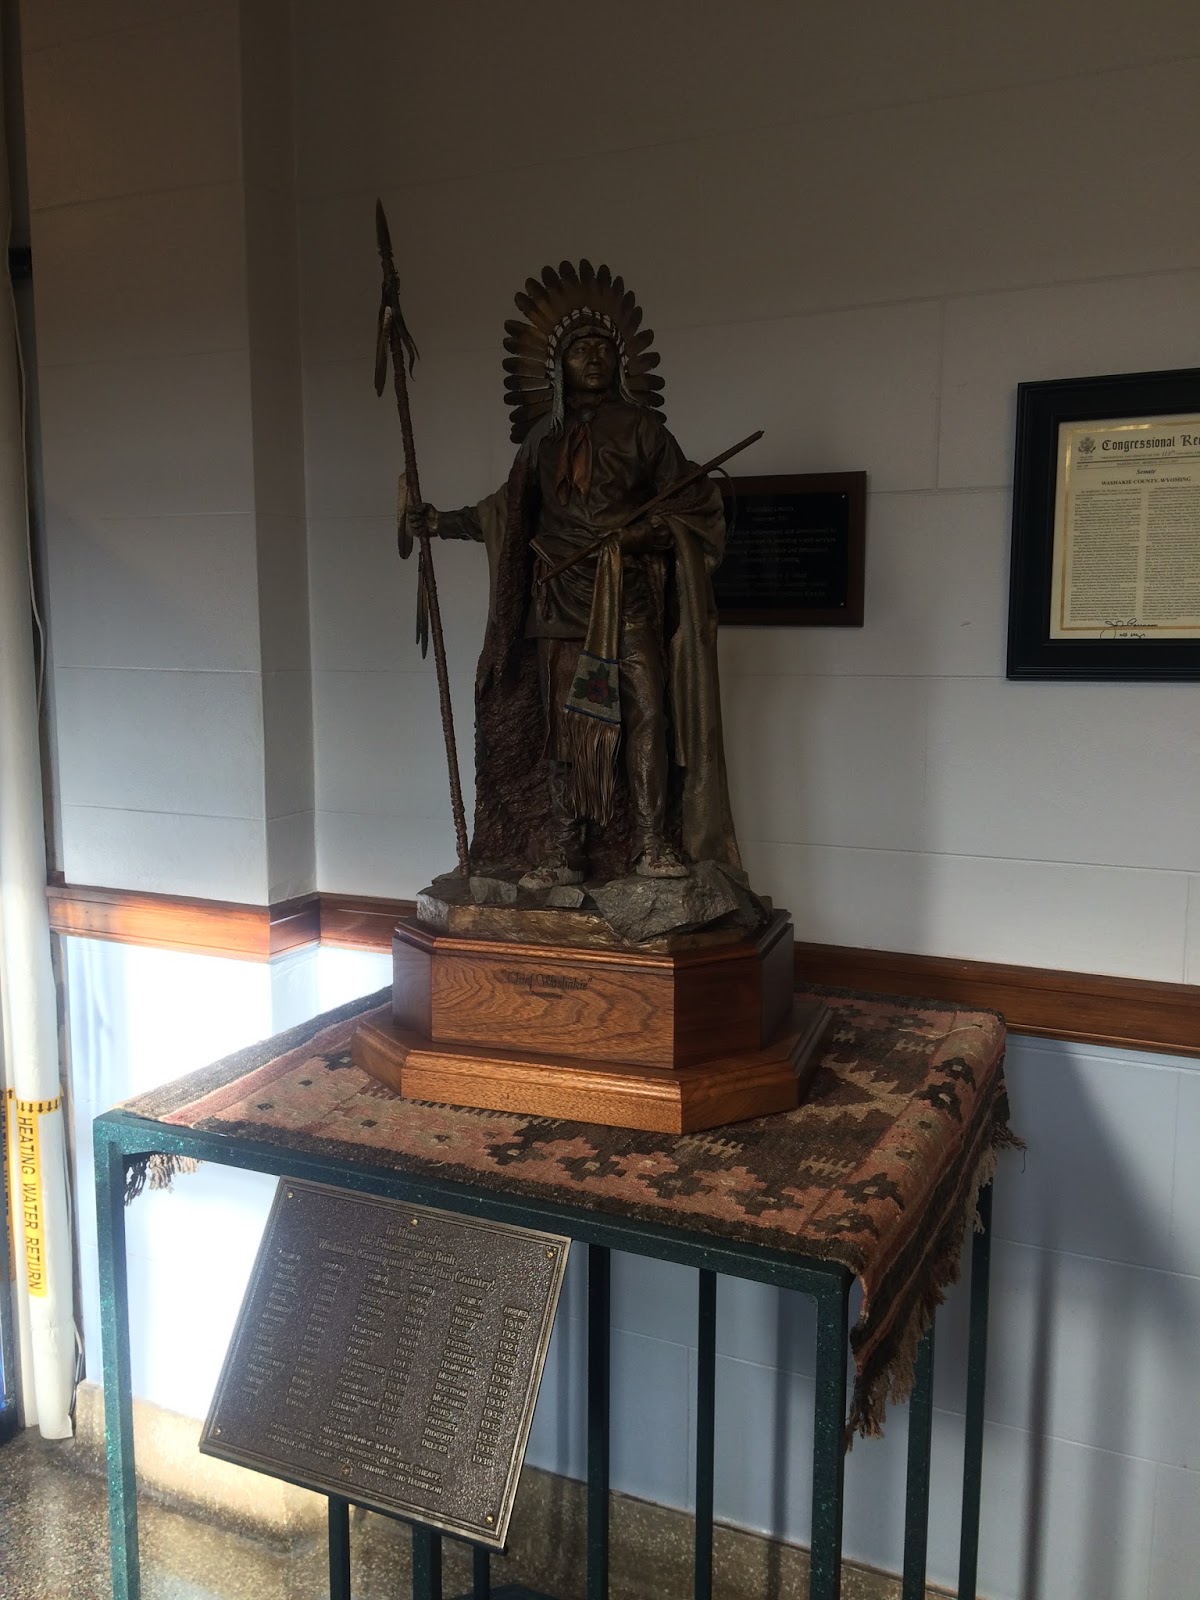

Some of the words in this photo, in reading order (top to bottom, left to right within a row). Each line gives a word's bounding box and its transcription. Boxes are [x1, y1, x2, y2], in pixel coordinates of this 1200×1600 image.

[1101, 436, 1176, 453] Congressional
[18, 1116, 36, 1175] HEATING
[22, 1182, 39, 1230] WATER
[385, 1224, 395, 1236] In
[396, 1227, 427, 1243] Honor
[426, 1233, 439, 1246] of
[359, 1233, 374, 1246] the
[375, 1237, 412, 1255] Pioneers
[413, 1246, 434, 1262] who
[434, 1250, 458, 1266] Built
[26, 1237, 43, 1291] RETURN
[317, 1238, 356, 1257] Washakie
[356, 1248, 389, 1267] County
[453, 1271, 497, 1293] Country!
[504, 1318, 524, 1330] 1919
[501, 1329, 522, 1341] 1921
[499, 1340, 519, 1352] 1921
[496, 1351, 517, 1364] 1925
[493, 1362, 514, 1375] 1926
[491, 1373, 511, 1386] 1930
[488, 1385, 509, 1398] 1930
[485, 1396, 506, 1409] 1931
[483, 1408, 504, 1421] 1932
[480, 1419, 501, 1432] 1932
[424, 1427, 454, 1443] RIDEOUT
[475, 1442, 496, 1456] 1935
[477, 1431, 498, 1444] 1935
[472, 1454, 493, 1468] 1938
[392, 1472, 407, 1483] AND
[407, 1477, 442, 1495] HARRISON
